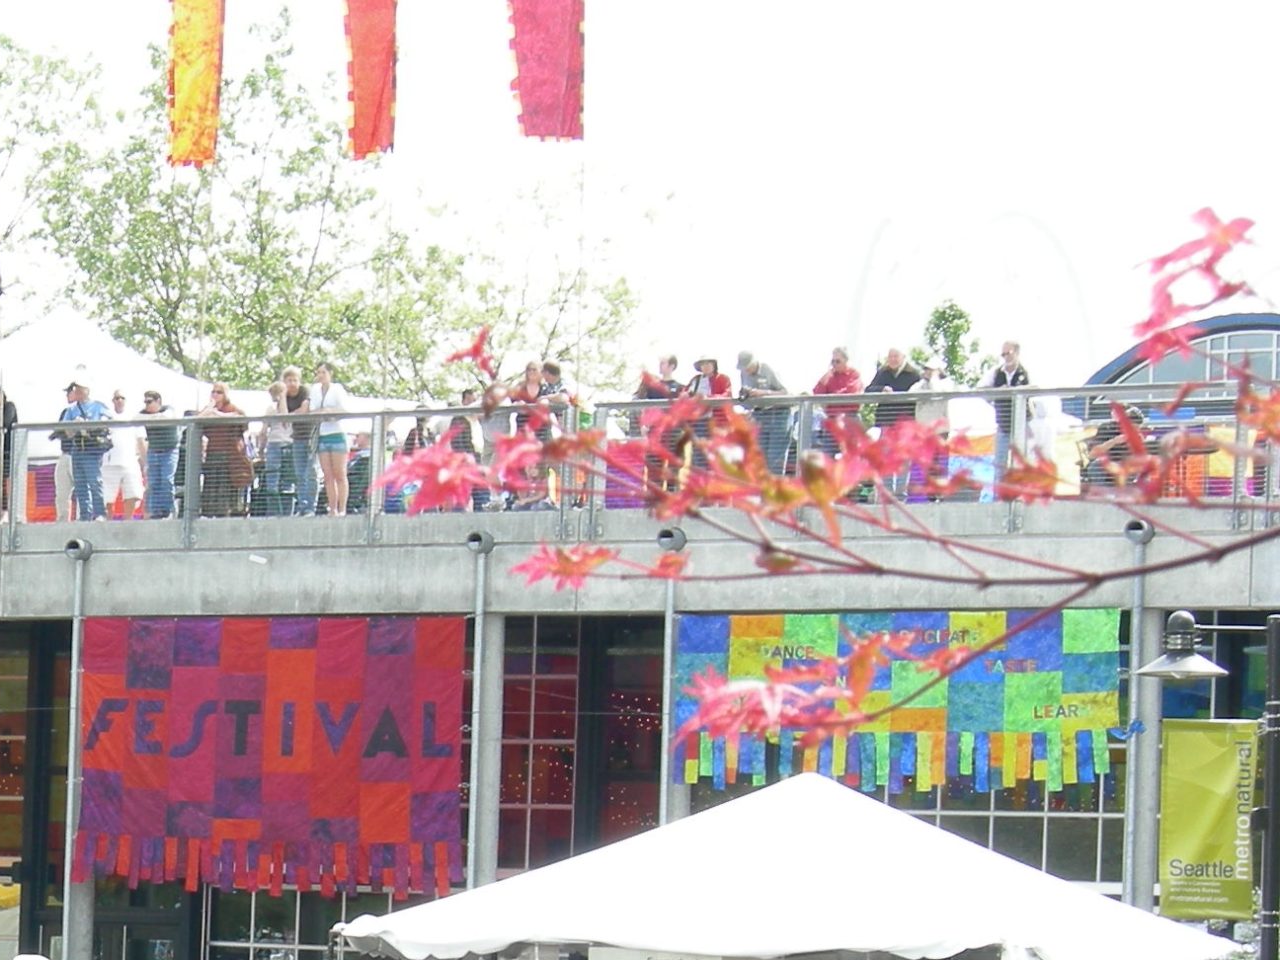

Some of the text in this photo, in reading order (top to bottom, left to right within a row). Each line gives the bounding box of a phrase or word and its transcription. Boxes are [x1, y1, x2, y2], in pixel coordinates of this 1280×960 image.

[985, 658, 1037, 673] TASTE
[84, 698, 454, 759] FESTIVAL
[1234, 740, 1252, 880] metronatural
[1169, 859, 1233, 879] Seattle
